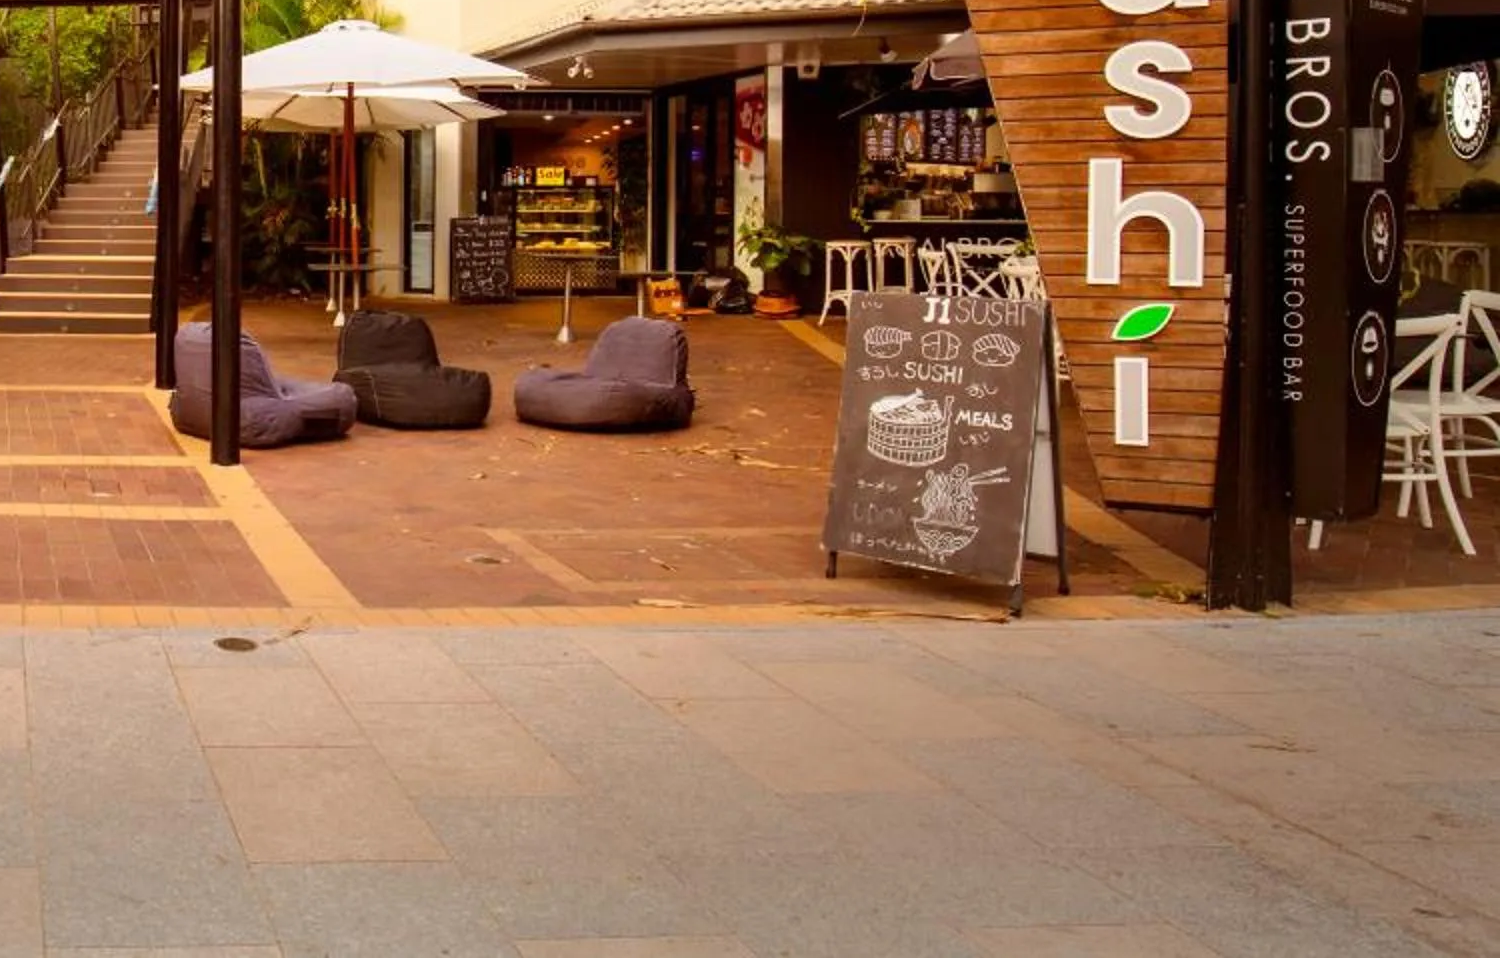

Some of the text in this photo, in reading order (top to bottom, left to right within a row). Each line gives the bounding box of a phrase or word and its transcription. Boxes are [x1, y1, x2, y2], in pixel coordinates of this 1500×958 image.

[1285, 17, 1332, 182] BROS.
[955, 299, 1028, 327] SUSHI
[1283, 204, 1306, 402] SUPERFOOD BAR
[903, 361, 964, 385] SUSHI
[955, 408, 1013, 431] MEALS
